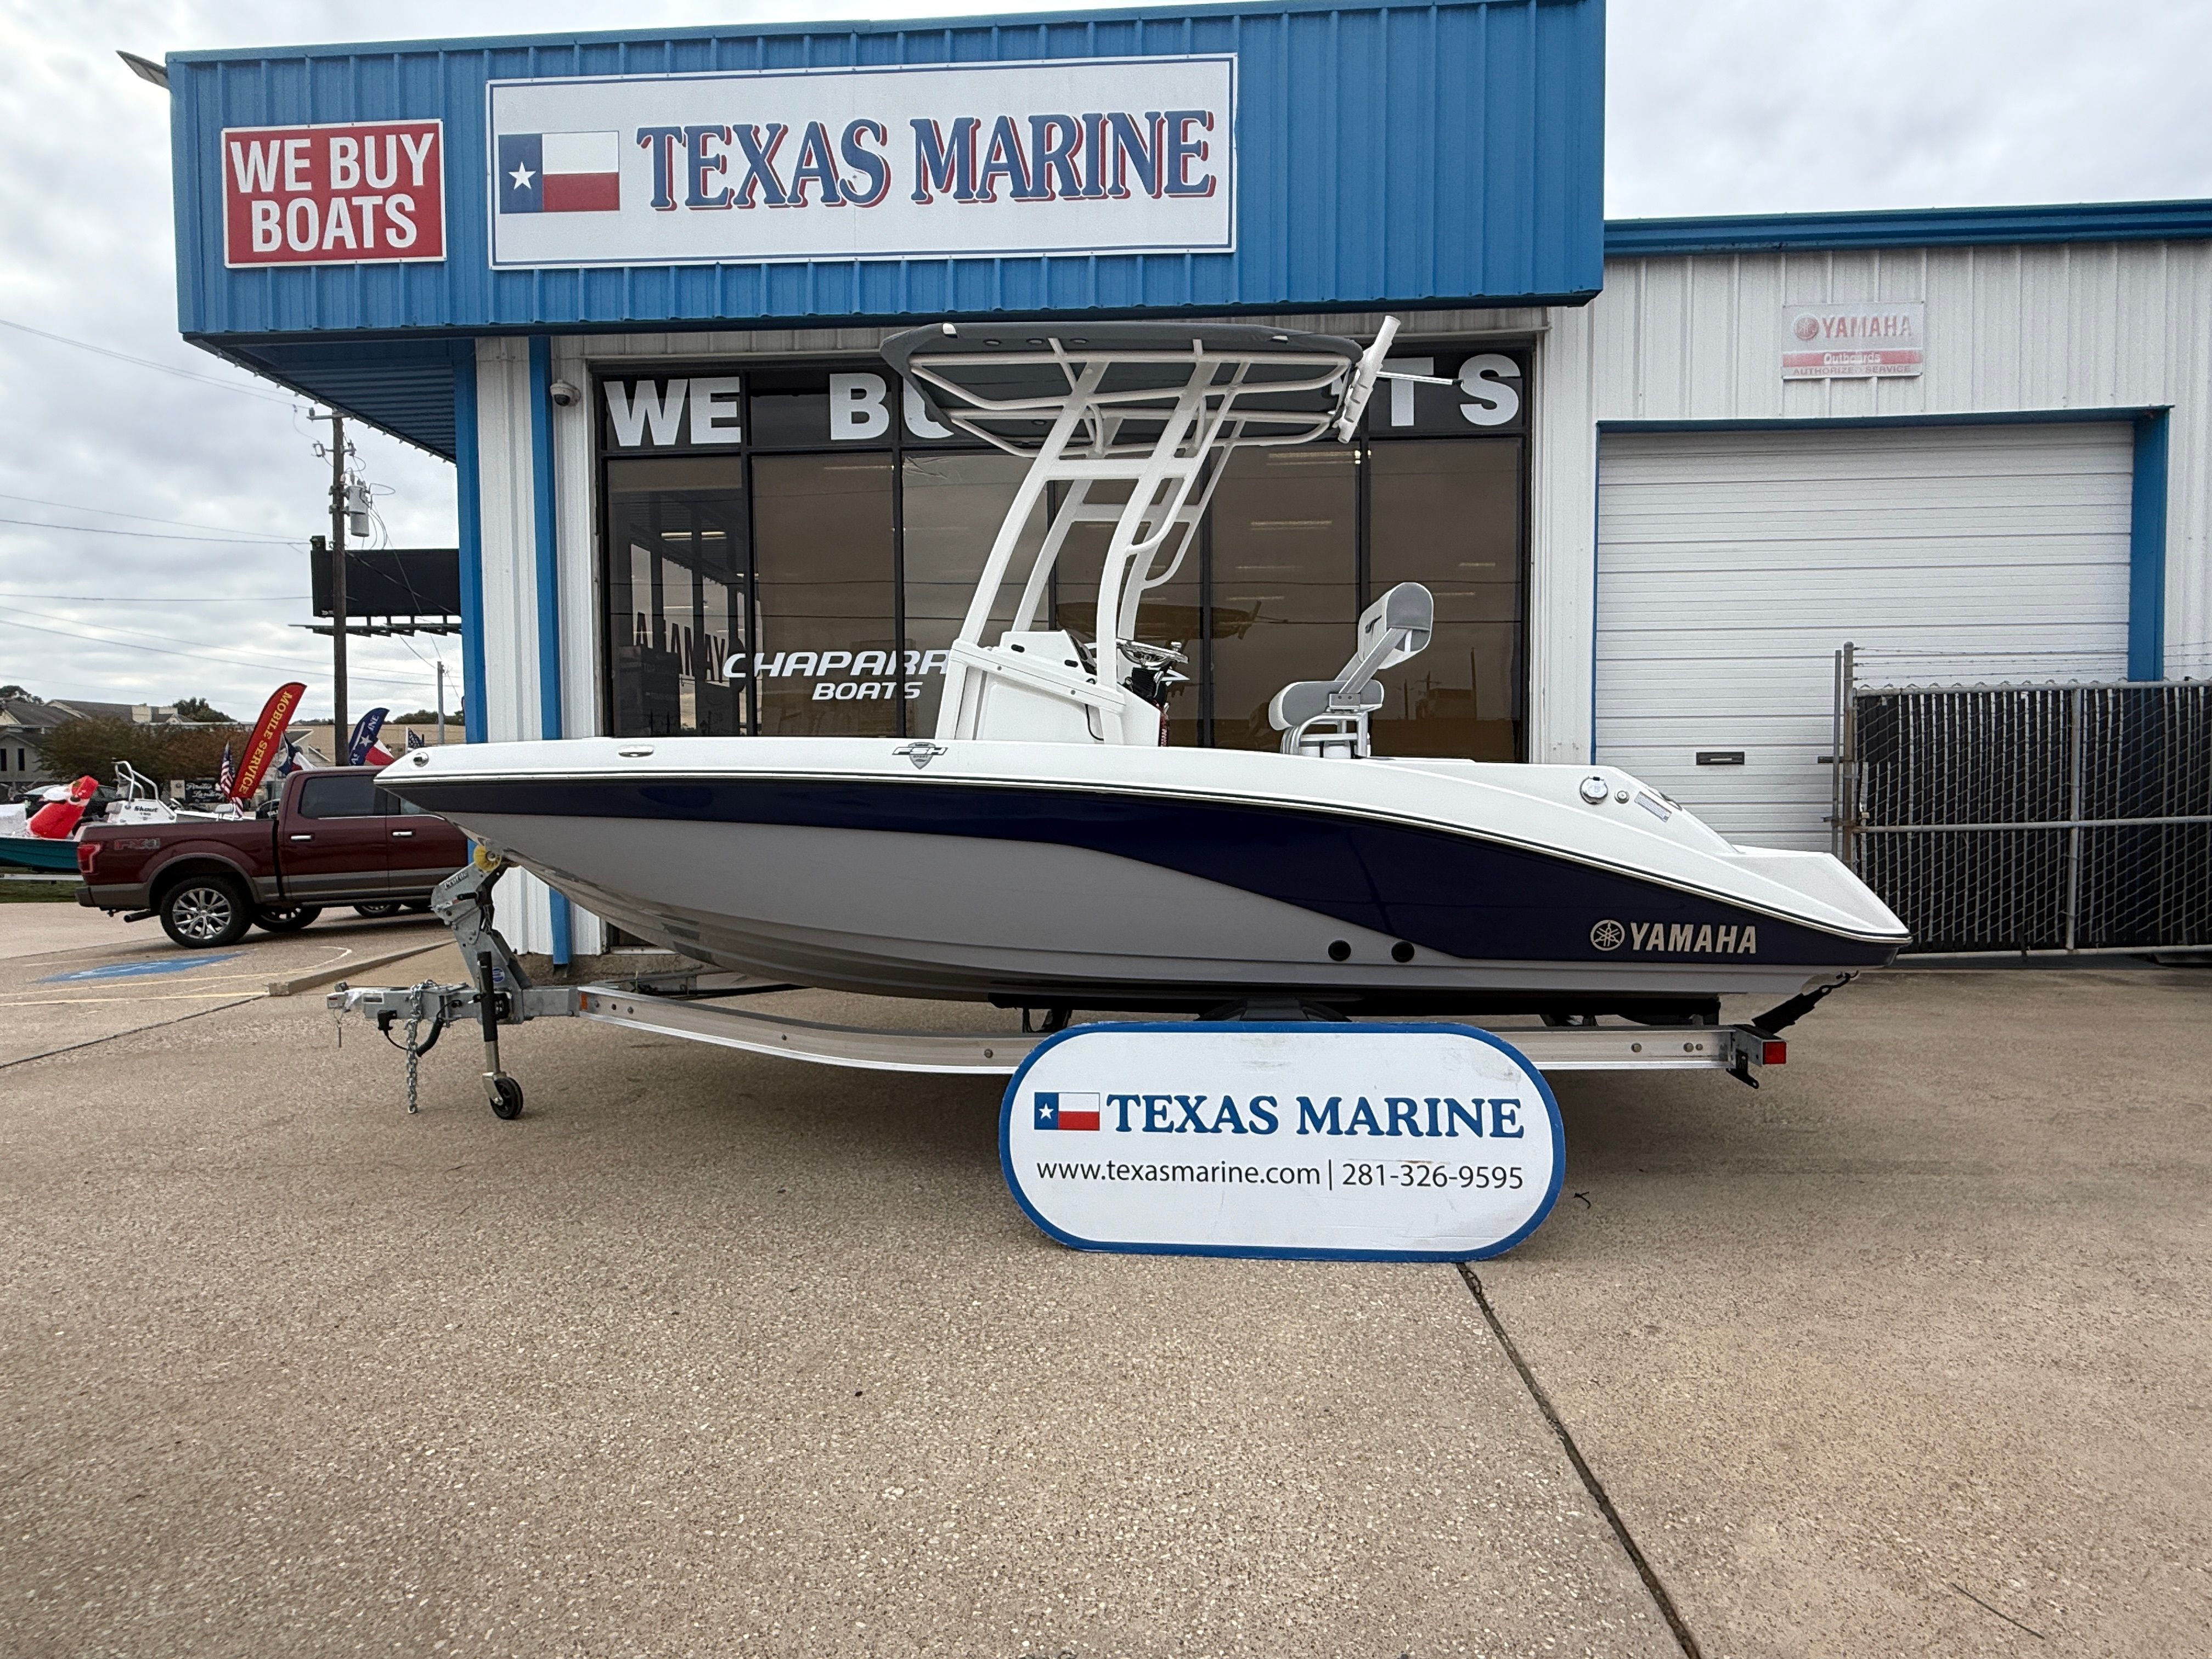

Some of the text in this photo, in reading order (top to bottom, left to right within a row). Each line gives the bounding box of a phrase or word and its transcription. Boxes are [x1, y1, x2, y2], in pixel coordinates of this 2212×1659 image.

[230, 133, 435, 193] WE BUY
[636, 110, 1216, 211] TEXAS MARINE
[251, 194, 417, 252] BOATS
[1821, 315, 1912, 338] YAMAHA
[603, 376, 741, 447] WE
[723, 650, 950, 678] CHAPARR
[812, 682, 923, 701] BOATS
[239, 691, 293, 794] MOBILE SERVICE
[893, 747, 946, 755] FSH
[1630, 922, 1757, 954] YAMAHA
[1106, 1093, 1525, 1139] TEXAS MARINE
[1036, 1159, 1524, 1190] www.texasmarine.com 281-326-9595
